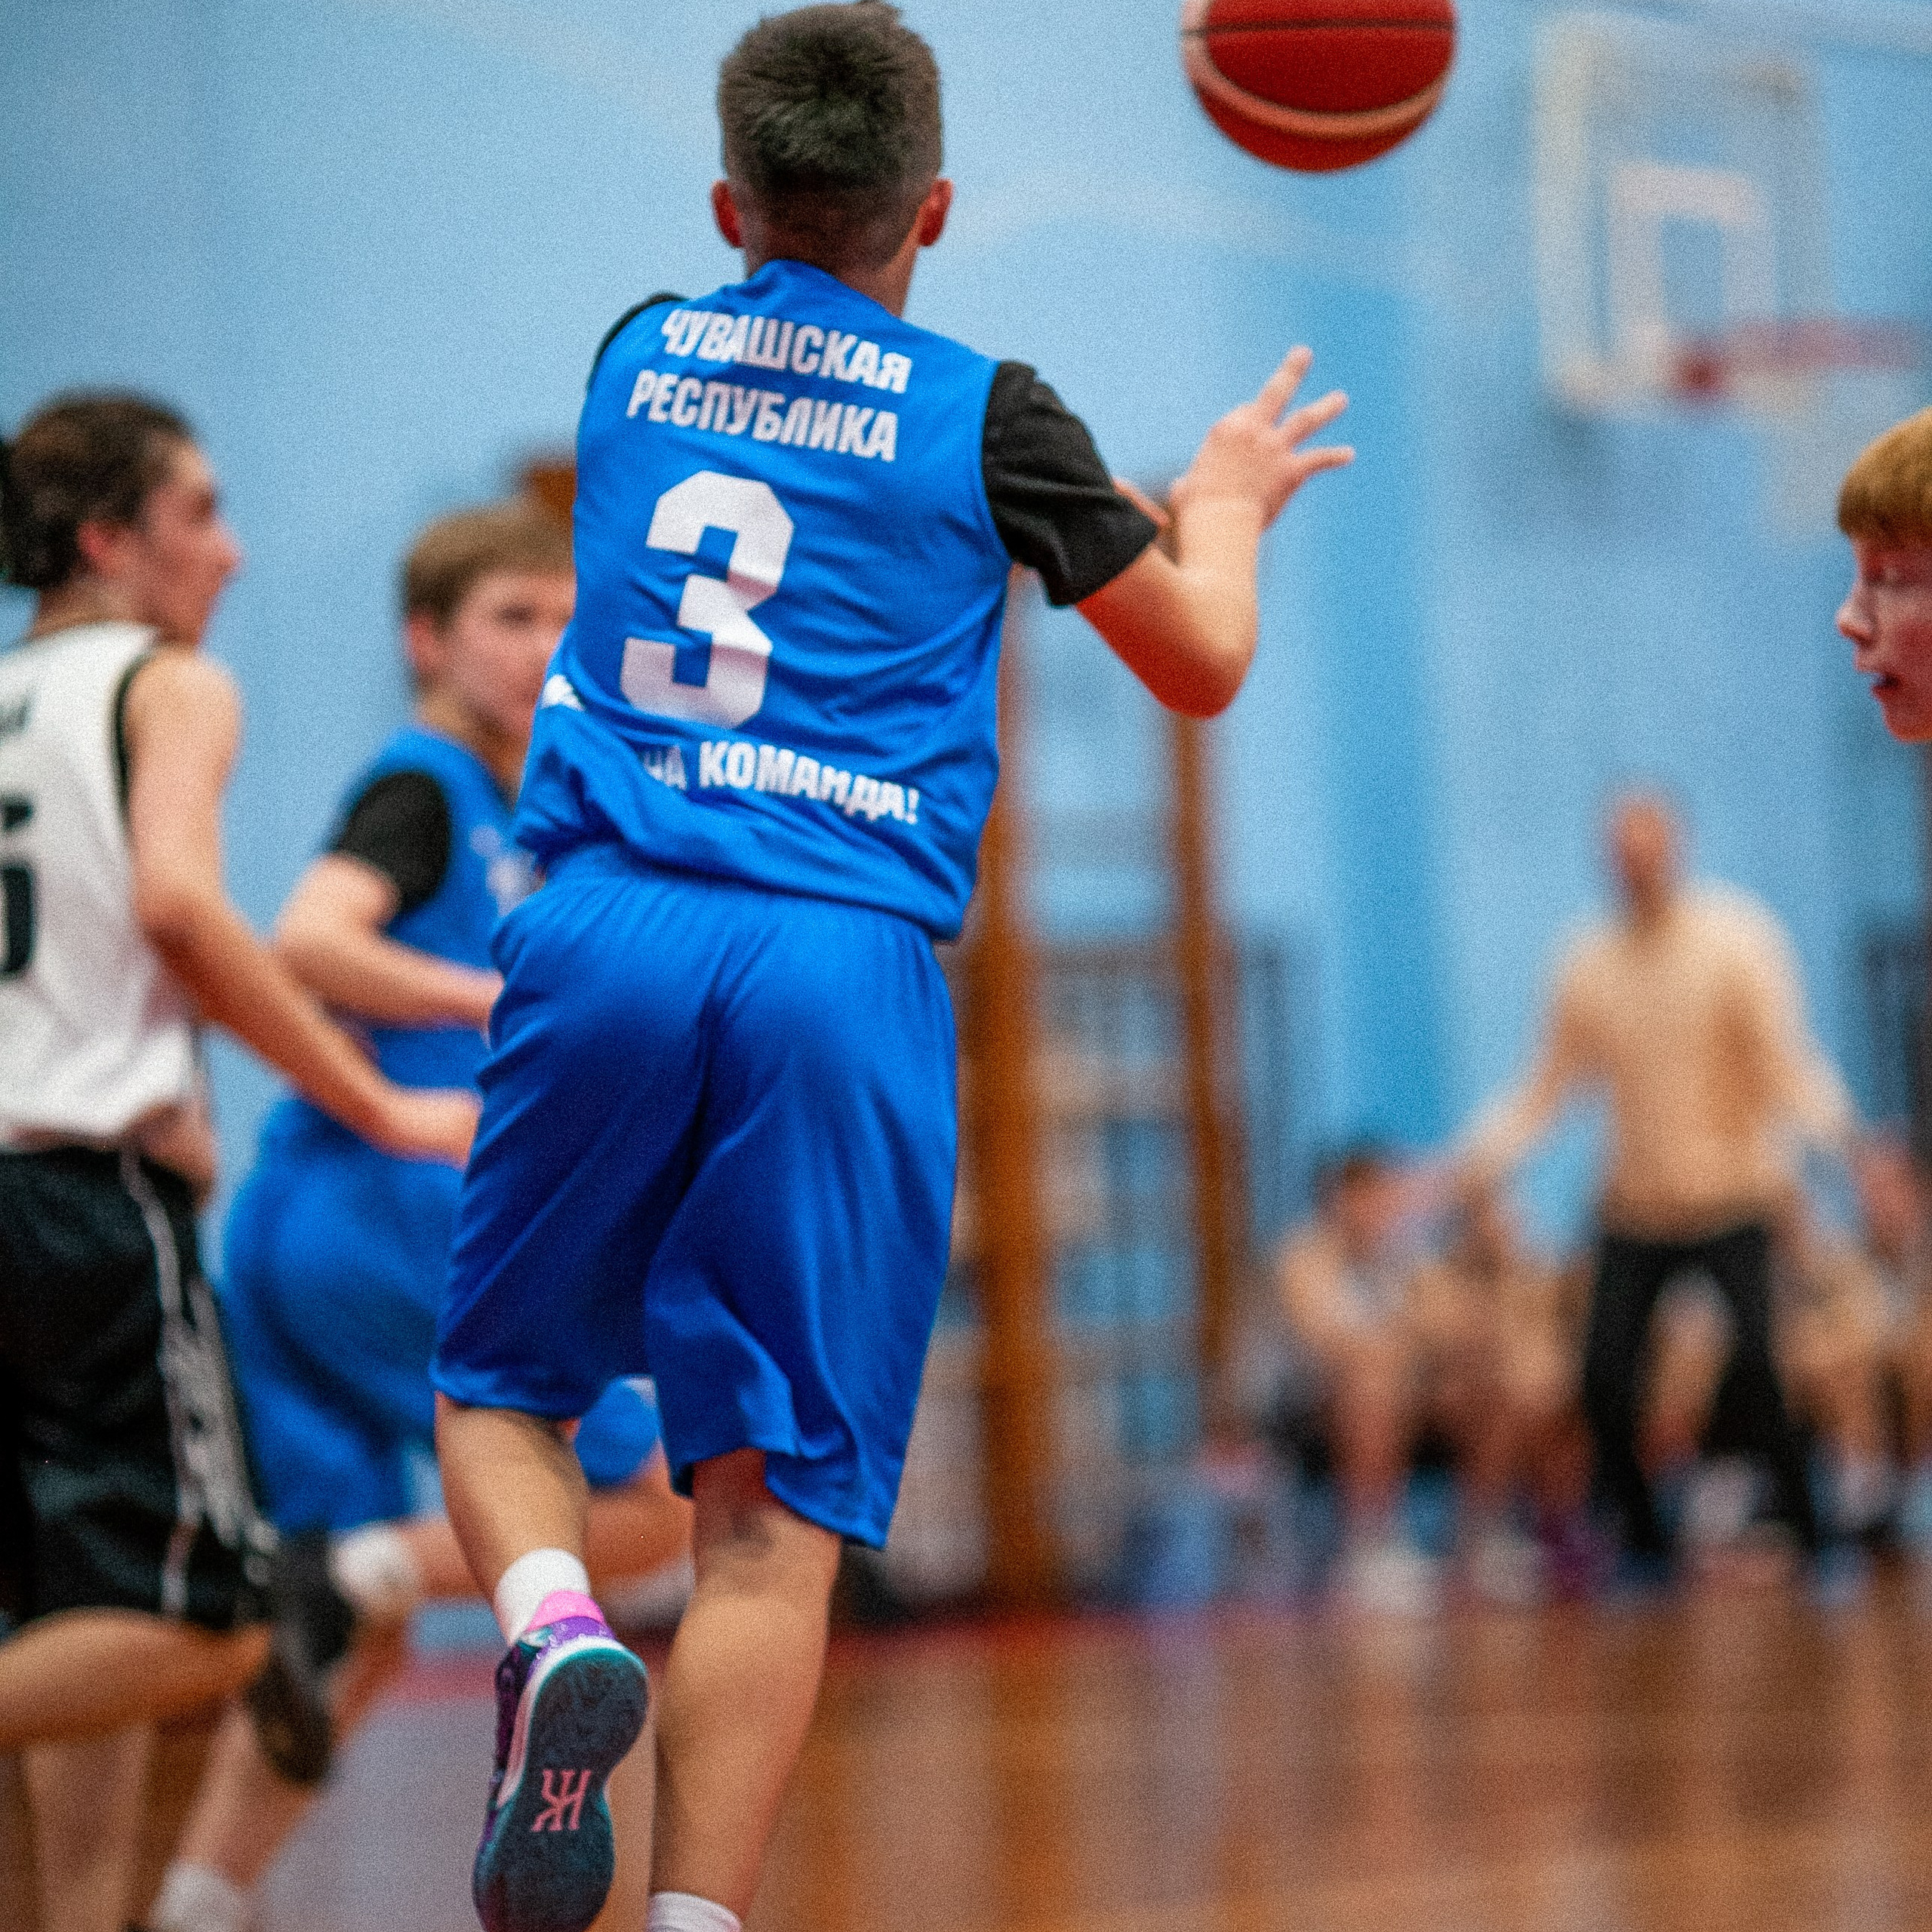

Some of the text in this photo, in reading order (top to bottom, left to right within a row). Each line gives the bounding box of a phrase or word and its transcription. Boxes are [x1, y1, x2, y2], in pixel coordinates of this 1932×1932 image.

[661, 308, 913, 394] ЧУВАШСКАЯ
[626, 369, 899, 462] РЕСПУБЛИКА
[620, 469, 795, 730] 3
[698, 740, 920, 825] КОМАНДА!
